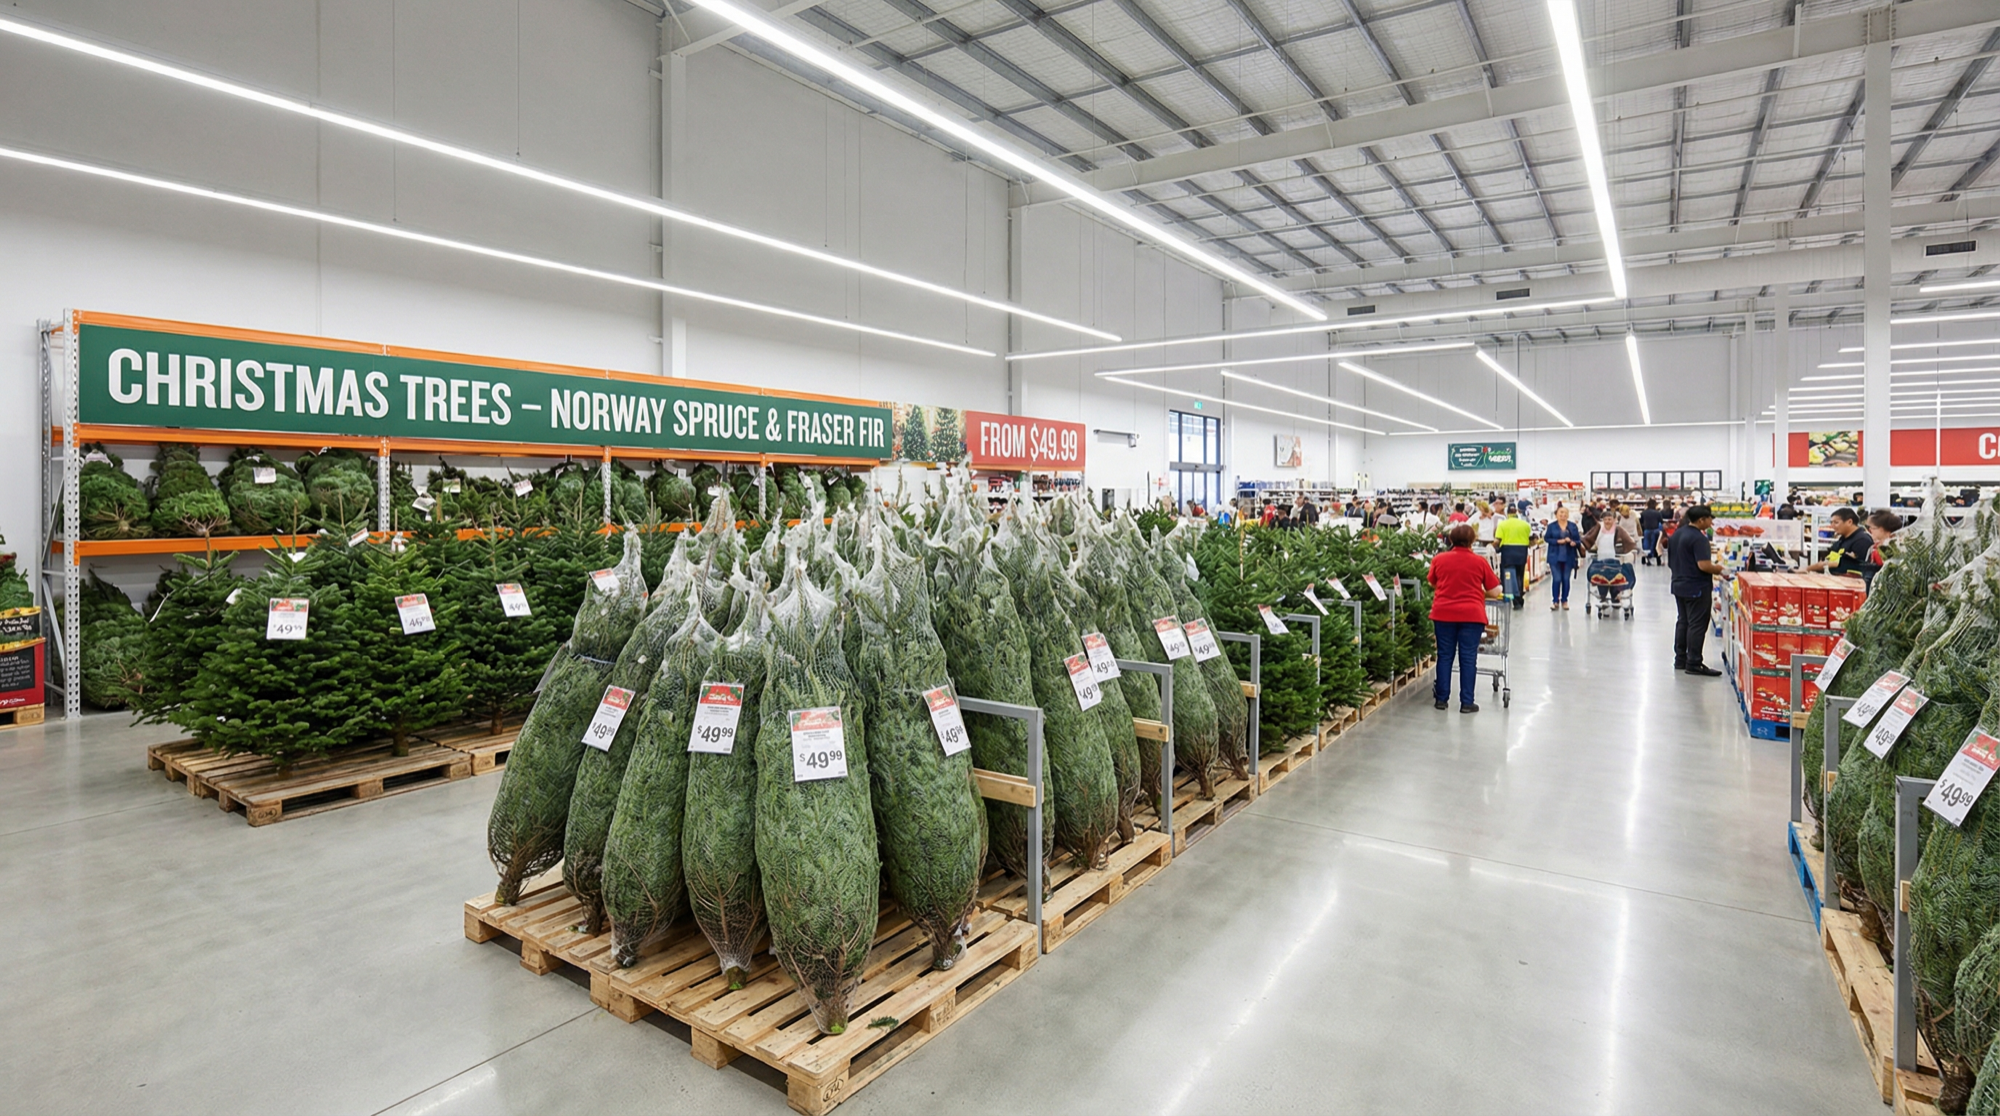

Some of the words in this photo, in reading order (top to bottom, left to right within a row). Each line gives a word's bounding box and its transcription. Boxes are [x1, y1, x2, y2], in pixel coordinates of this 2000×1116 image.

[108, 348, 389, 418] CHRISTMAS
[399, 374, 512, 426] TREES
[550, 388, 667, 435] NORWAY
[673, 399, 760, 441] SPRUCE
[765, 407, 782, 442] &
[787, 411, 855, 447] FRASER
[859, 416, 885, 448] FIR
[979, 420, 1027, 458] FROM
[1029, 422, 1079, 462] $49.99
[1978, 432, 2000, 460] C
